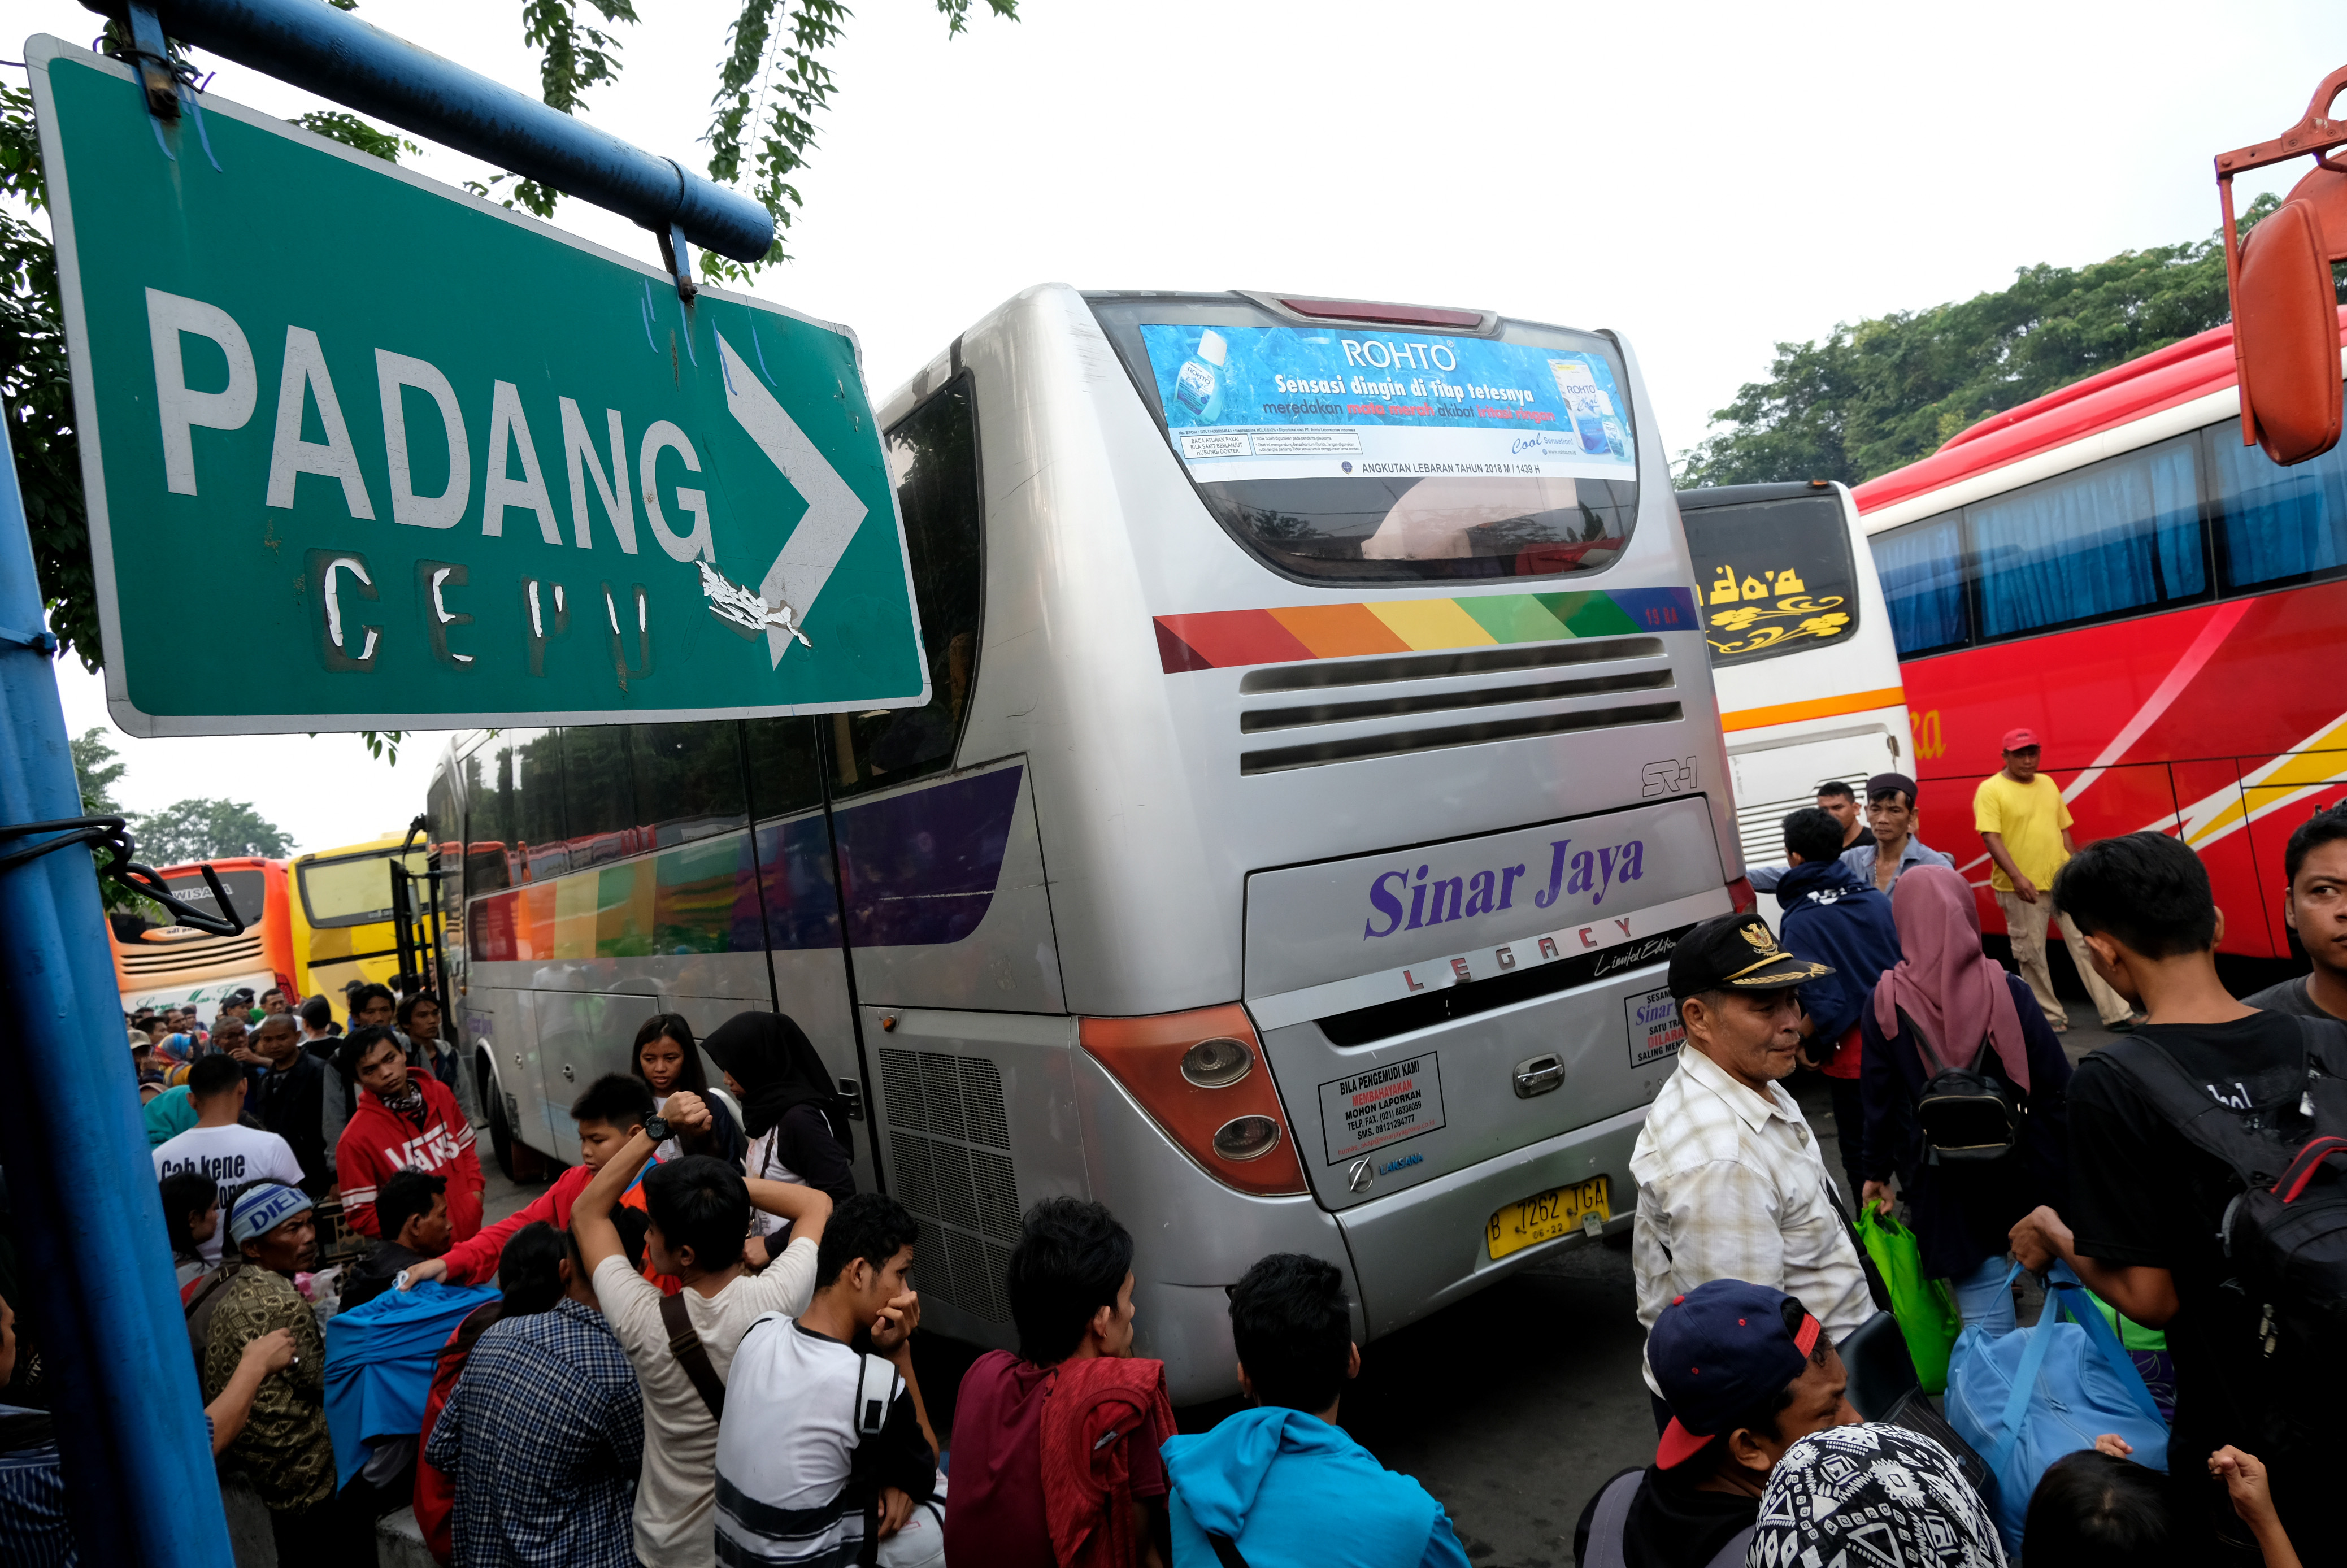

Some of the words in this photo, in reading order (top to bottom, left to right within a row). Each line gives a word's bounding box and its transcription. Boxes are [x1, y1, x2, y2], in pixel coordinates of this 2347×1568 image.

[1187, 366, 1210, 384] ROHTO
[1275, 374, 1346, 394] Sensasi
[1351, 376, 1407, 401] dingin
[1410, 377, 1428, 397] di
[1431, 379, 1464, 403] tiap
[1467, 383, 1535, 407] tetesnya
[1567, 385, 1596, 394] ROHTO
[1263, 399, 1343, 414] meredakan
[1347, 402, 1385, 415] mata
[1388, 402, 1435, 416] merah
[1438, 403, 1475, 417] akibat
[1476, 405, 1512, 419] iritasi
[1515, 407, 1555, 424] ringan
[145, 286, 716, 564] PADANG
[1511, 432, 1542, 454] Cool
[1362, 463, 1411, 474] ANGKUTAN
[1412, 463, 1454, 474] LEBARAN
[1455, 463, 1483, 474] TAHUN
[1484, 463, 1502, 474] 2018
[1503, 464, 1511, 474] M
[1516, 464, 1533, 474] 1439
[1535, 464, 1541, 474] H
[171, 883, 234, 902] WISAA
[1363, 863, 1525, 941] Sinar
[1535, 839, 1644, 909] Jaya
[1403, 918, 1632, 992] LEGACY
[1594, 946, 1641, 977] Limited
[1647, 989, 1672, 1004] SESAM
[1636, 1002, 1674, 1026] Sinar
[1648, 1027, 1687, 1049] DILARA
[1649, 1023, 1667, 1035] SATU
[1638, 1046, 1663, 1061] SALING
[1340, 1079, 1357, 1096] BILA
[1358, 1065, 1401, 1090] PENGEMUDI
[1402, 1060, 1420, 1076] KAMI
[1345, 1104, 1377, 1120] MOHON
[1379, 1089, 1422, 1111] LAPORKAN
[1352, 1079, 1413, 1107] MEMBAHAYAKAN
[1380, 1109, 1394, 1123] (021)
[1396, 1101, 1422, 1117] 88336059
[1338, 1119, 1435, 1156] humas_akap@sinarjayagroup.co.id
[1357, 1128, 1374, 1140] SMS.
[1375, 1114, 1415, 1135] 08121284777
[384, 1121, 460, 1174] VANS
[201, 1154, 245, 1181] kene
[1379, 1152, 1424, 1175] LAKSANA
[1490, 1213, 1501, 1240] B
[1517, 1193, 1559, 1230] 7262
[1571, 1180, 1604, 1211] TGA
